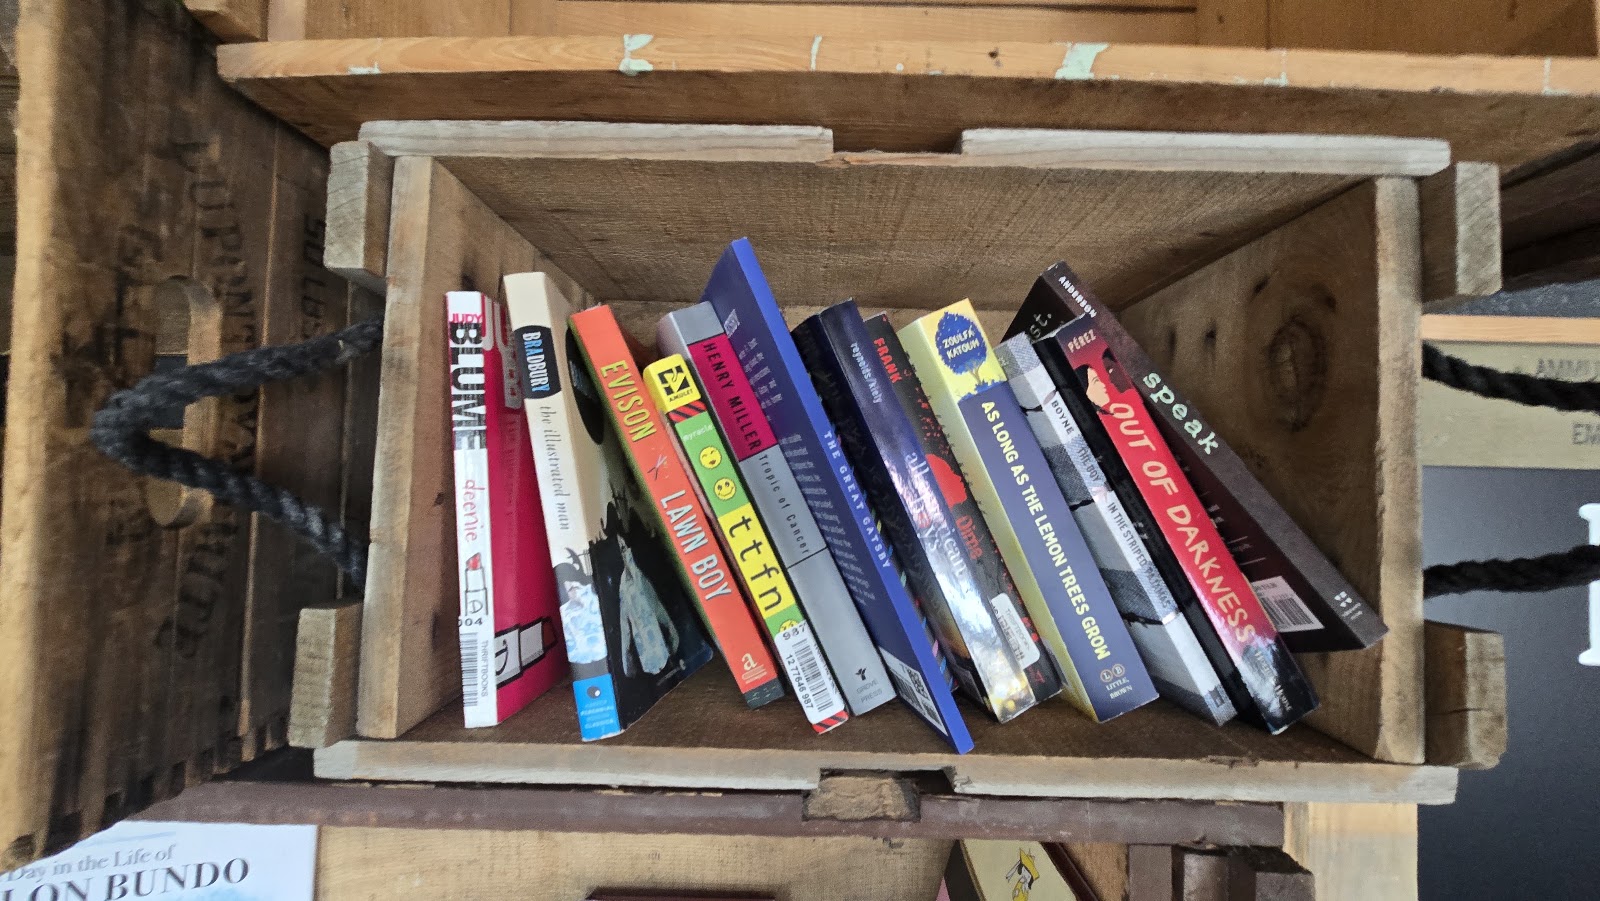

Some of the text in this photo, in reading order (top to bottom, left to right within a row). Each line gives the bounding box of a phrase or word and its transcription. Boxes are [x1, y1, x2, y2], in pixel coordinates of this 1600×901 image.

[452, 313, 483, 323] JUDY
[1029, 312, 1052, 339] st.
[1058, 276, 1098, 319] ANDERSON
[450, 322, 487, 450] BLUME
[522, 331, 550, 393] BRADBURY
[873, 337, 903, 383] FRANK
[600, 360, 657, 442] EVISON
[669, 389, 693, 402] AMULET
[703, 343, 734, 389] HENRY
[728, 396, 762, 451] MILLER
[1051, 400, 1075, 435] BOYNE
[1142, 372, 1219, 455] speak
[539, 406, 571, 530] the illustrated man
[904, 452, 930, 476] all
[462, 479, 486, 542] deenie
[759, 455, 809, 555] Tropic of Cancer
[823, 431, 841, 460] THE
[840, 465, 864, 511] GREAT
[862, 517, 891, 569] GATSBY
[913, 494, 940, 551] bys
[981, 401, 1111, 661] AS LONG AS THE LEMON TREES GROW
[1077, 447, 1090, 465] THE
[1086, 464, 1100, 482] BOY
[1107, 502, 1116, 514] IN
[1113, 513, 1127, 532] THE
[1123, 530, 1148, 567] STRIPED
[1109, 402, 1157, 452] OUT
[1142, 461, 1179, 495] OF
[1167, 504, 1257, 643] DARKNESS
[660, 490, 732, 601] LAWN BOY
[729, 515, 783, 611] ttfn
[782, 622, 807, 641] 987
[478, 639, 489, 698] THRIFTBOOKS
[786, 654, 795, 665] 12
[802, 694, 813, 709] 987
[7, 844, 177, 883] Day in the Life of
[105, 857, 249, 901] BUNDO
